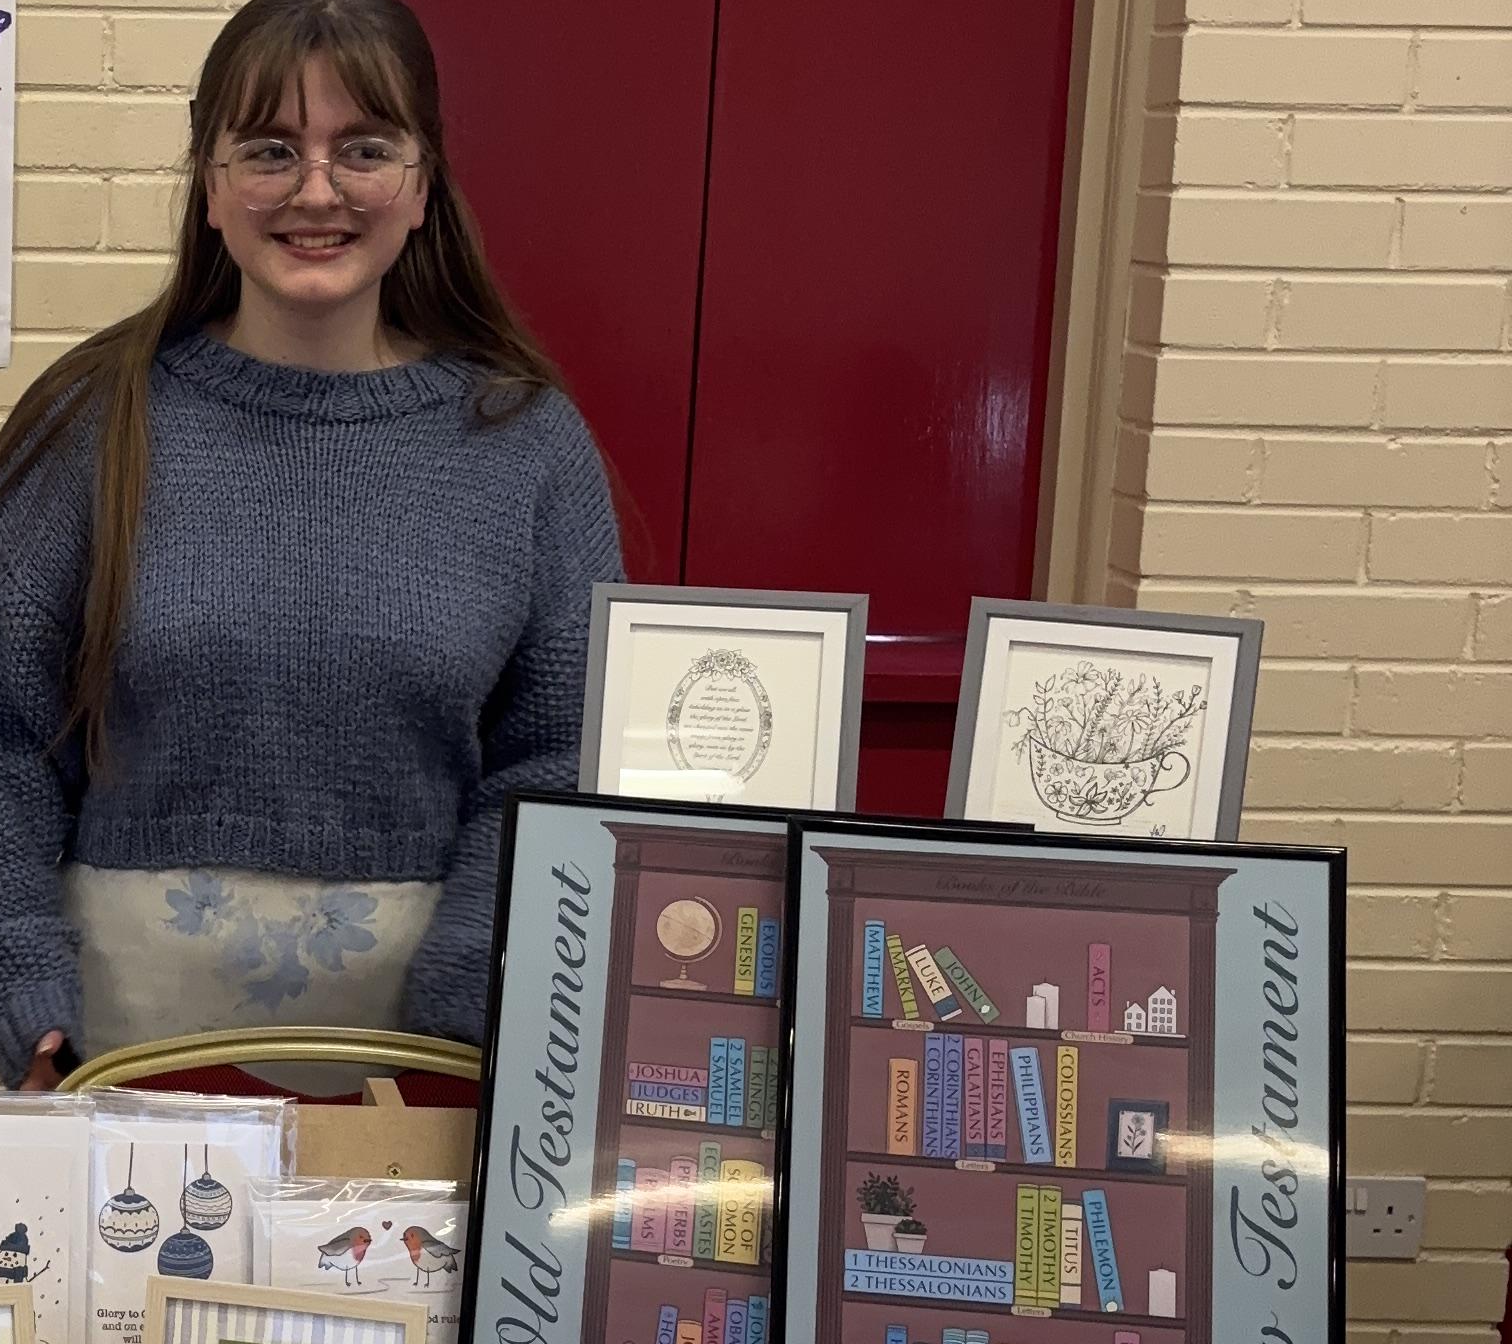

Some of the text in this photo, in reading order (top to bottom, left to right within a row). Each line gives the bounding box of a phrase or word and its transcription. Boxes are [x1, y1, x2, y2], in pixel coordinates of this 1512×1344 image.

[738, 912, 755, 978] GENESIS
[758, 923, 776, 991] EXODUS
[866, 929, 881, 1012] MATTHEW
[889, 950, 913, 999] MARK
[914, 956, 945, 997] LUKE
[944, 960, 983, 1004] JOHN
[1091, 966, 1107, 1006] ACTS
[509, 859, 592, 1226] Testament
[635, 1064, 701, 1083] JOSHUA
[635, 1102, 680, 1119] RUTH
[637, 1082, 700, 1103] JUDGES
[708, 1054, 725, 1119] SAMUEL
[727, 1056, 744, 1122] SAMUEL
[894, 1069, 910, 1144] ROMANS
[924, 1046, 940, 1158] CORINTHIANS
[943, 1047, 961, 1158] CORINTHIANS
[966, 1047, 982, 1141] GALATIANS
[989, 1051, 1006, 1140] EPHESIANS
[1017, 1055, 1045, 1157] PHILIPPIANS
[1058, 1052, 1075, 1160] COLOSSIANS
[1229, 898, 1301, 1291] Testament
[852, 1253, 1007, 1279] 1 THESSALONIANS
[1018, 1206, 1035, 1287] TIMOTHY
[1041, 1206, 1057, 1288] TIMOTHY
[1063, 1226, 1079, 1275] TITUS
[1088, 1200, 1116, 1292] PHILEMON
[96, 1308, 139, 1320] Glory to
[850, 1275, 1007, 1299] 2 THESSALONIANS
[101, 1322, 137, 1332] and on
[122, 1335, 142, 1344] will
